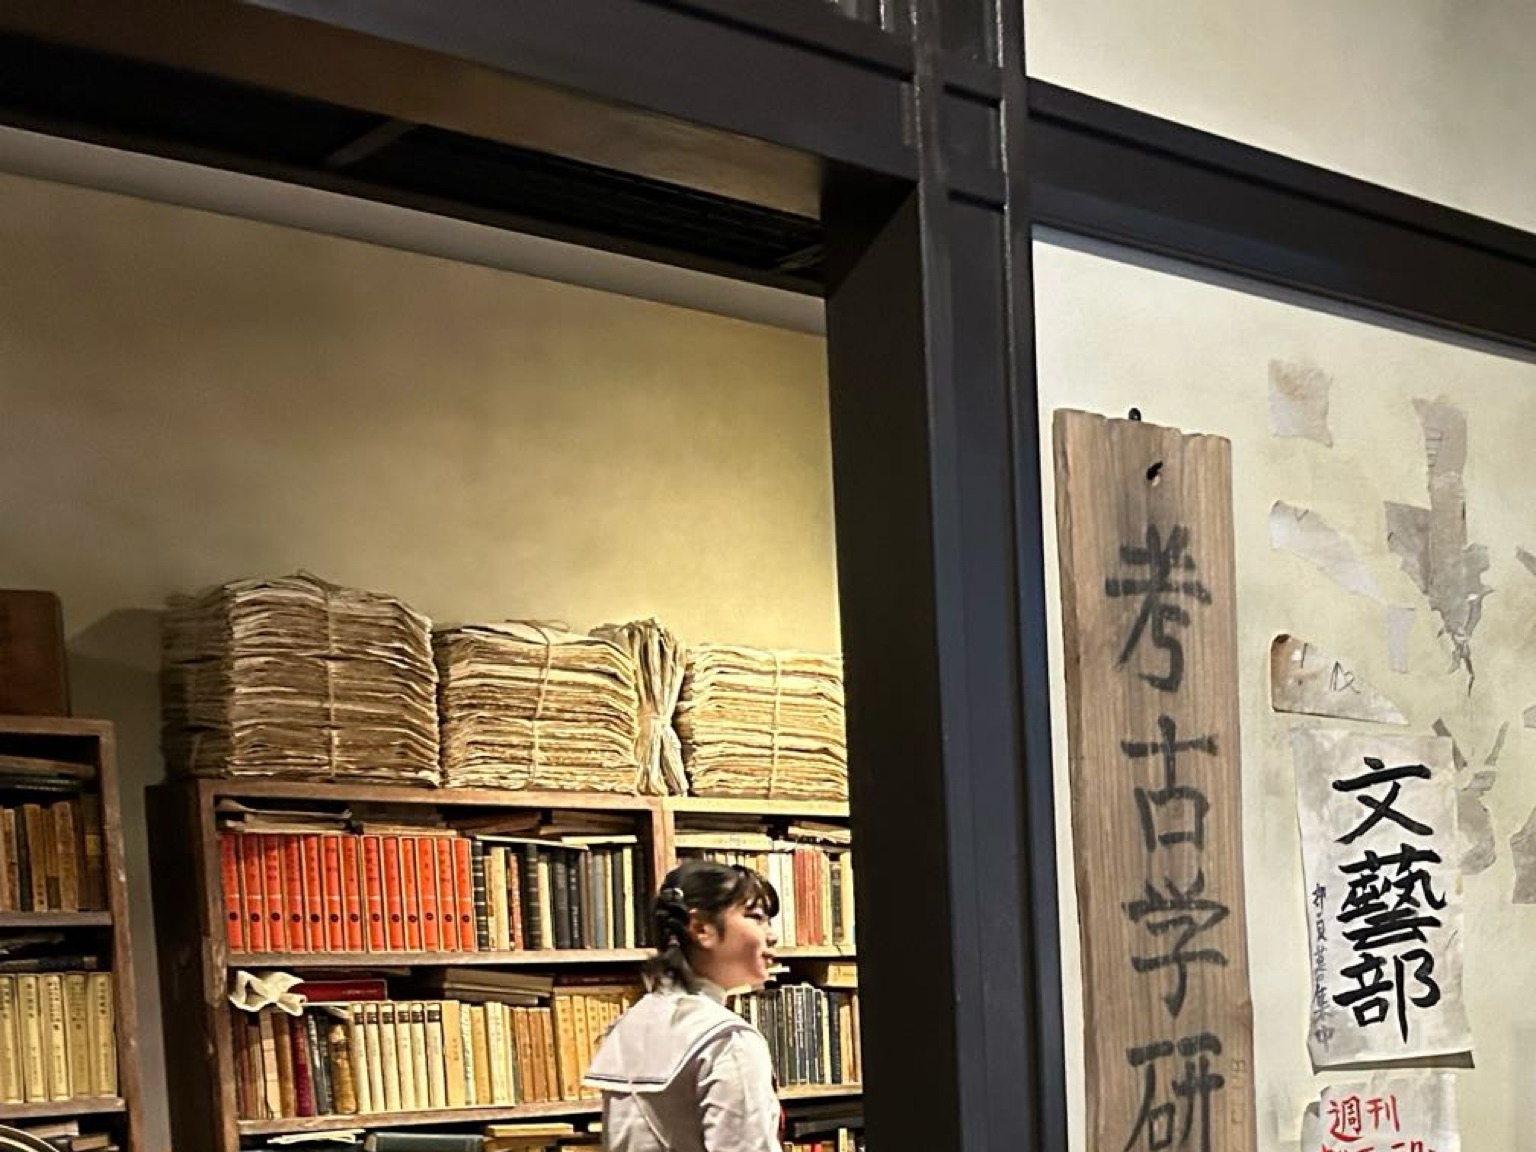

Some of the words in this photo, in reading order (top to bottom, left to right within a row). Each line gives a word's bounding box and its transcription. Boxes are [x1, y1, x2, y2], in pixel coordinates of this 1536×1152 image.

[1332, 756, 1448, 1045] 文藝部
[1327, 1095, 1400, 1142] 週刊
